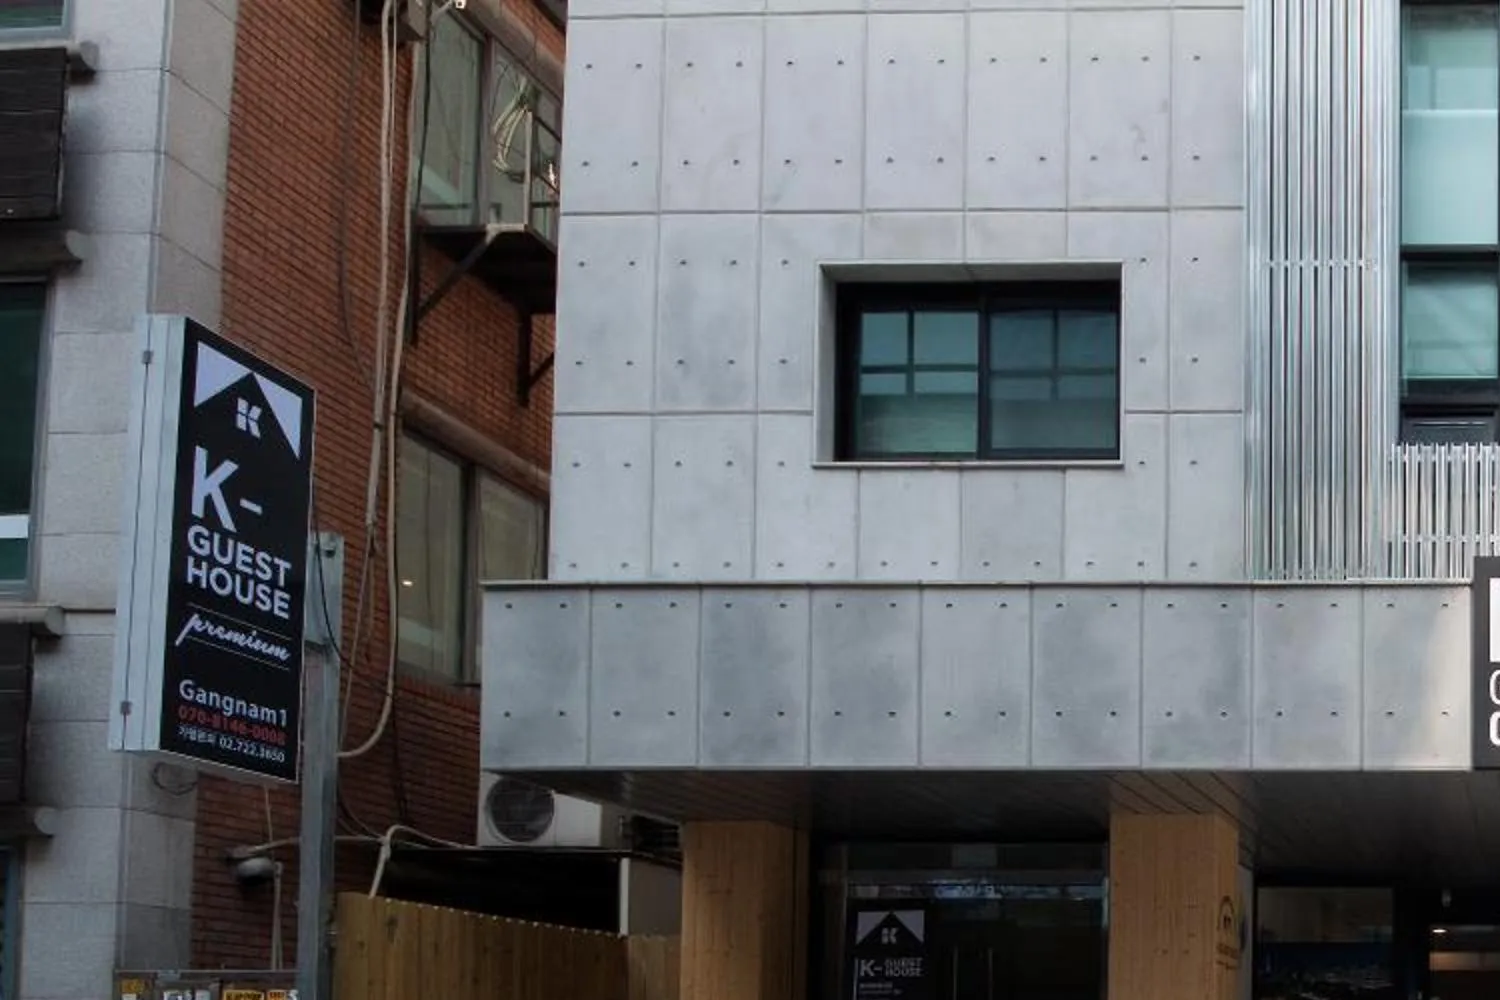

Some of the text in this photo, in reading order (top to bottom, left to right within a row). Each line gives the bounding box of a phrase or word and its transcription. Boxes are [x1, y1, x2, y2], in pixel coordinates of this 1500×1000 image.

[236, 397, 261, 438] K
[192, 445, 262, 533] K-
[187, 556, 291, 619] HOUSE
[188, 525, 292, 588] GUEST
